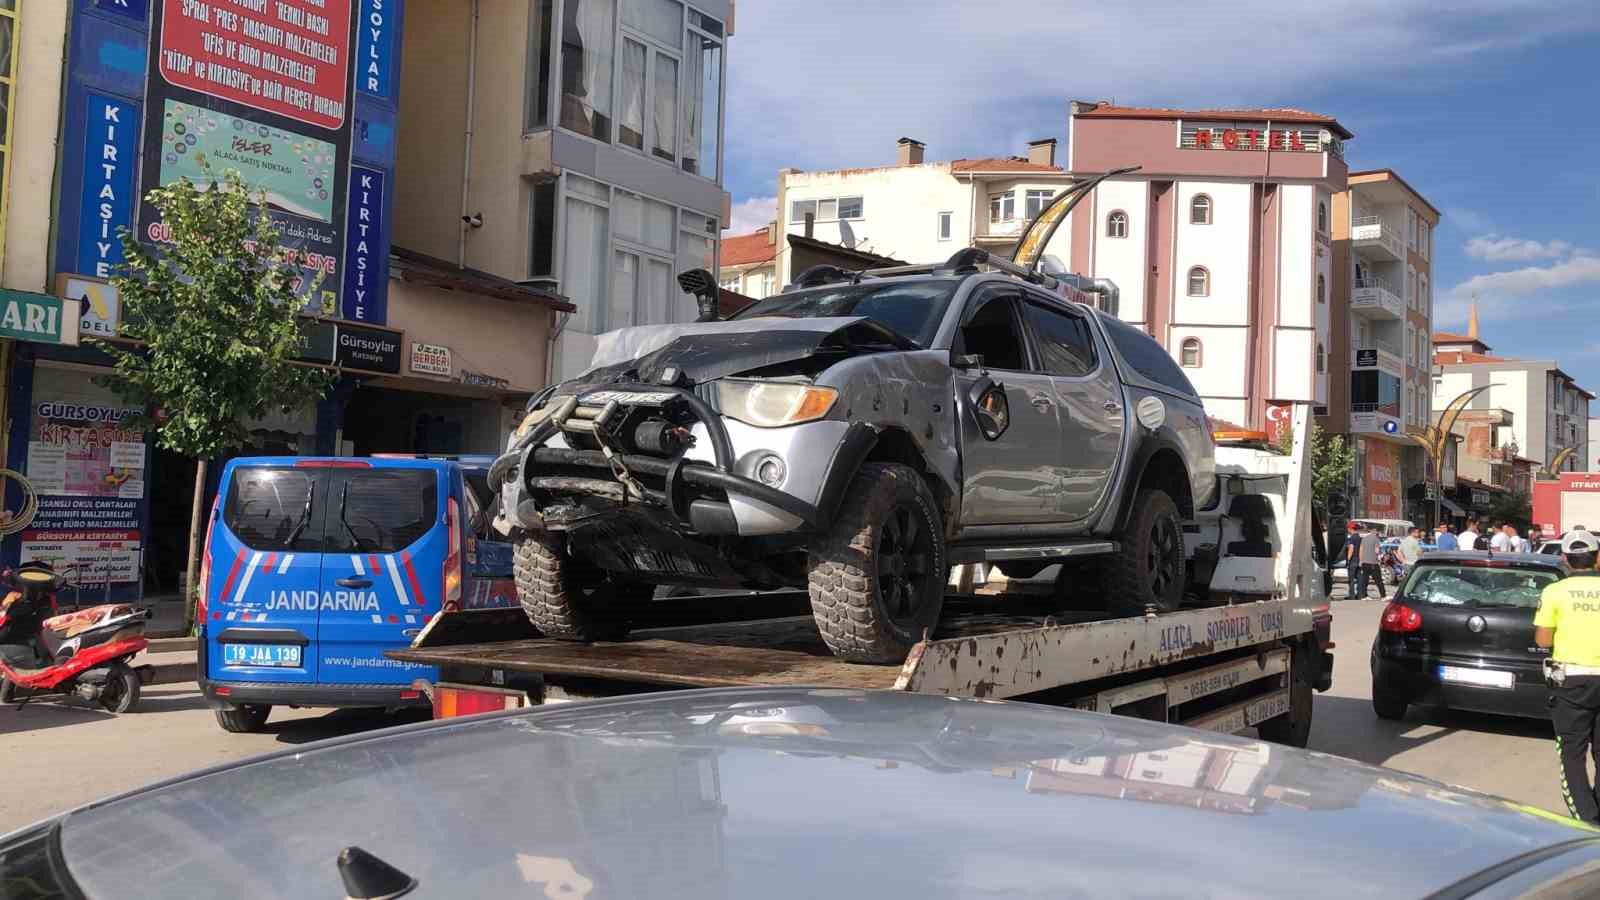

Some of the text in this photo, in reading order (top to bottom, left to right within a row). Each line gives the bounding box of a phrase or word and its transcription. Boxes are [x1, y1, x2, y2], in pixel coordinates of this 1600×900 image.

[307, 12, 328, 36] BASKI
[95, 104, 120, 278] KIRTASİYE
[354, 174, 373, 320] KIRTASİYE
[0, 300, 58, 335] ARI
[80, 320, 112, 333] DEL
[340, 334, 397, 353] Gürsoylar
[265, 590, 380, 611] JANDARMA
[232, 646, 298, 661] 19 JAA 139
